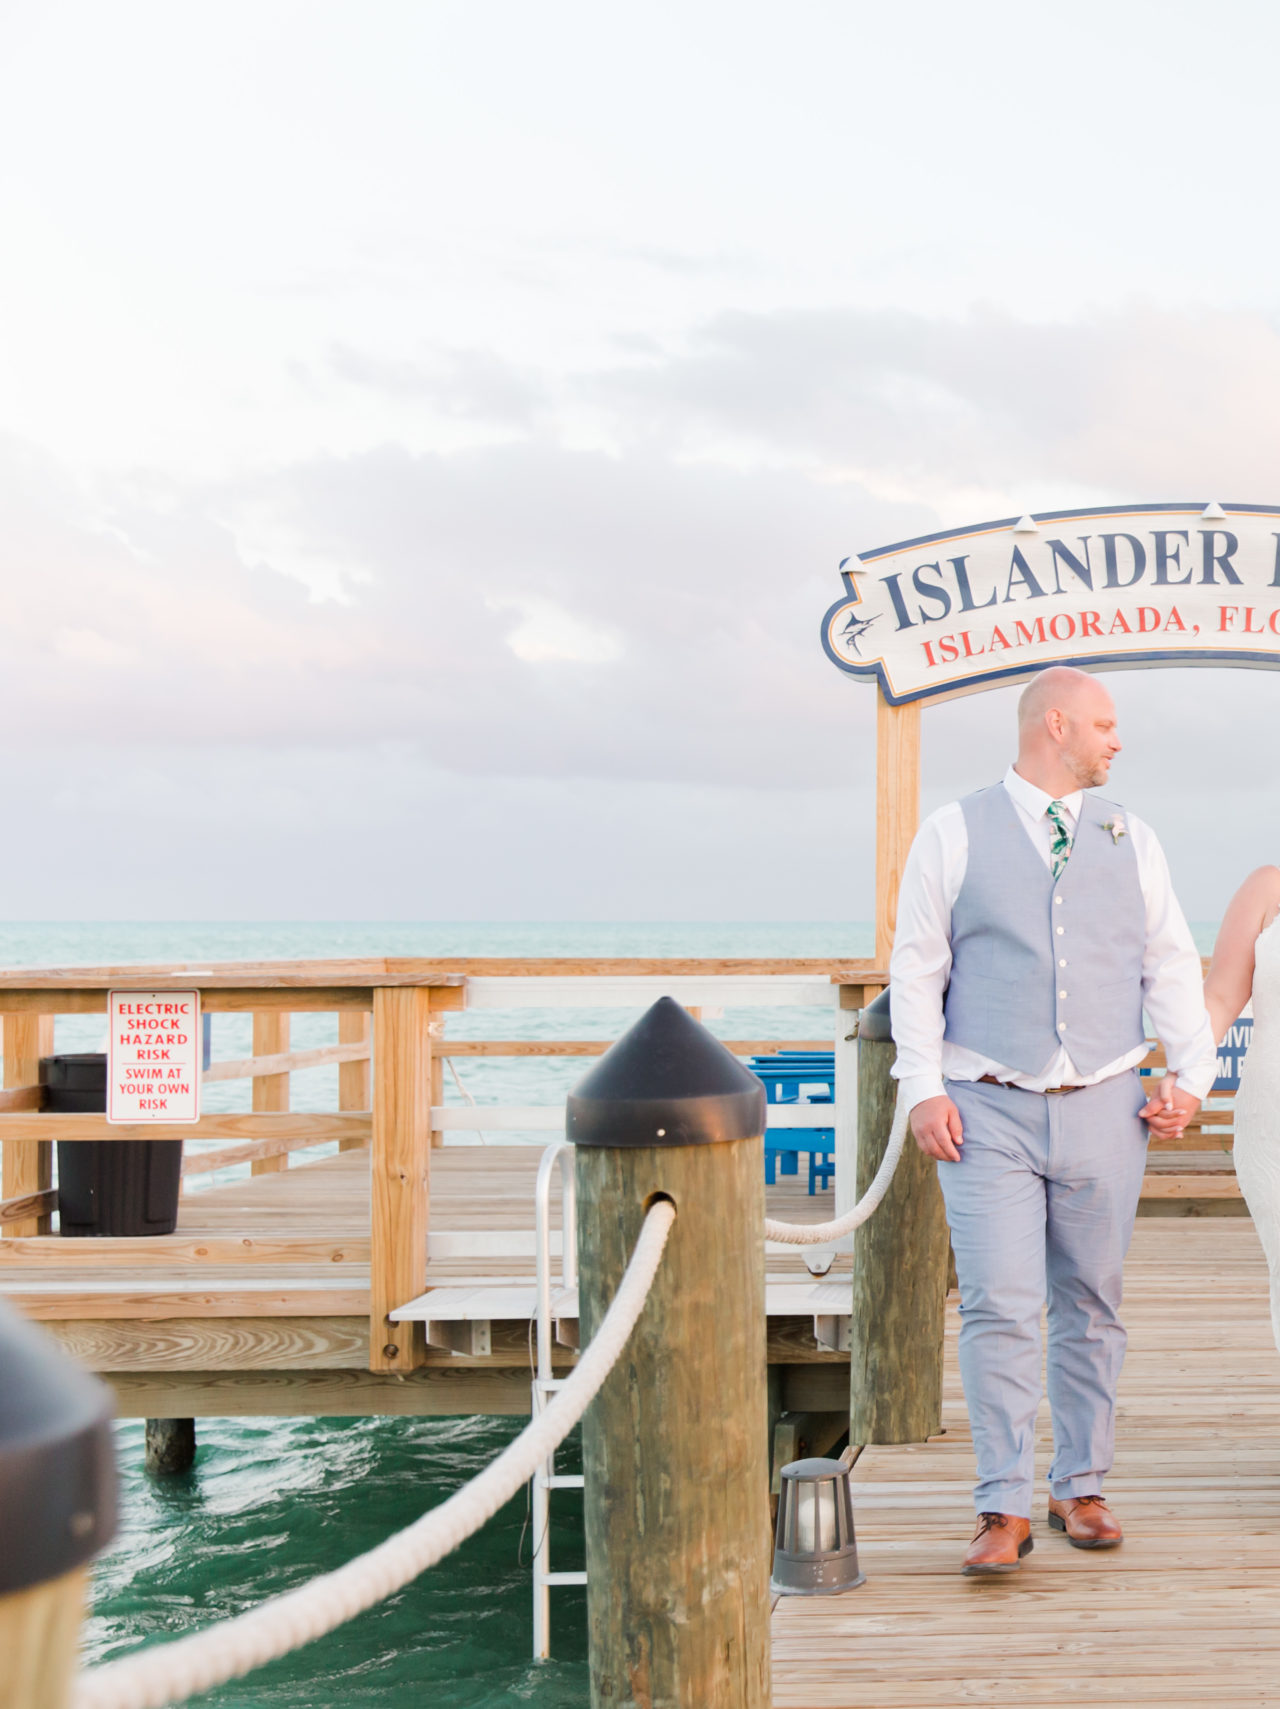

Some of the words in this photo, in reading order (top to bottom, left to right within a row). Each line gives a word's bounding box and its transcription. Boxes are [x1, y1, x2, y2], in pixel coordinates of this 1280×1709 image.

[878, 529, 1244, 632] ISLANDER
[919, 605, 1200, 668] ISLAMORADA,
[118, 1003, 190, 1015] ELECTRIC
[127, 1018, 181, 1030] SHOCK
[120, 1034, 188, 1045] HAZARD
[136, 1049, 171, 1060] RISK
[125, 1068, 163, 1080] SWIM
[167, 1068, 182, 1079] AT
[119, 1083, 154, 1095] YOUR
[157, 1083, 190, 1095] OWN
[138, 1098, 168, 1110] RISK
